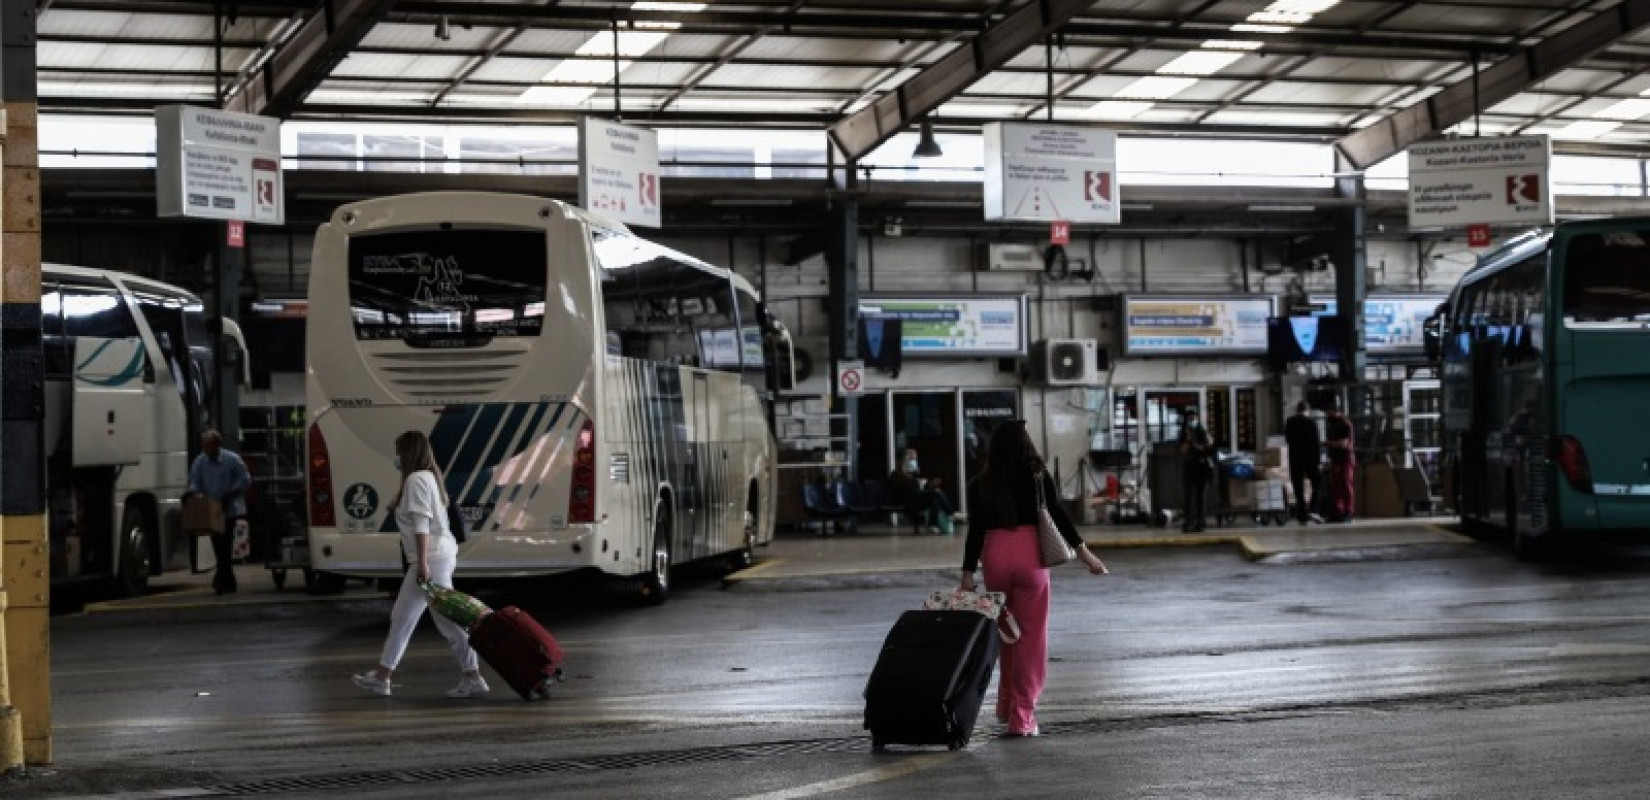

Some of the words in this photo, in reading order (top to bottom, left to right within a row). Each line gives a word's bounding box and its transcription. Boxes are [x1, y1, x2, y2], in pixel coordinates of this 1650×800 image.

[230, 226, 242, 239] 12
[1055, 226, 1067, 238] 14
[1472, 230, 1486, 241] 15
